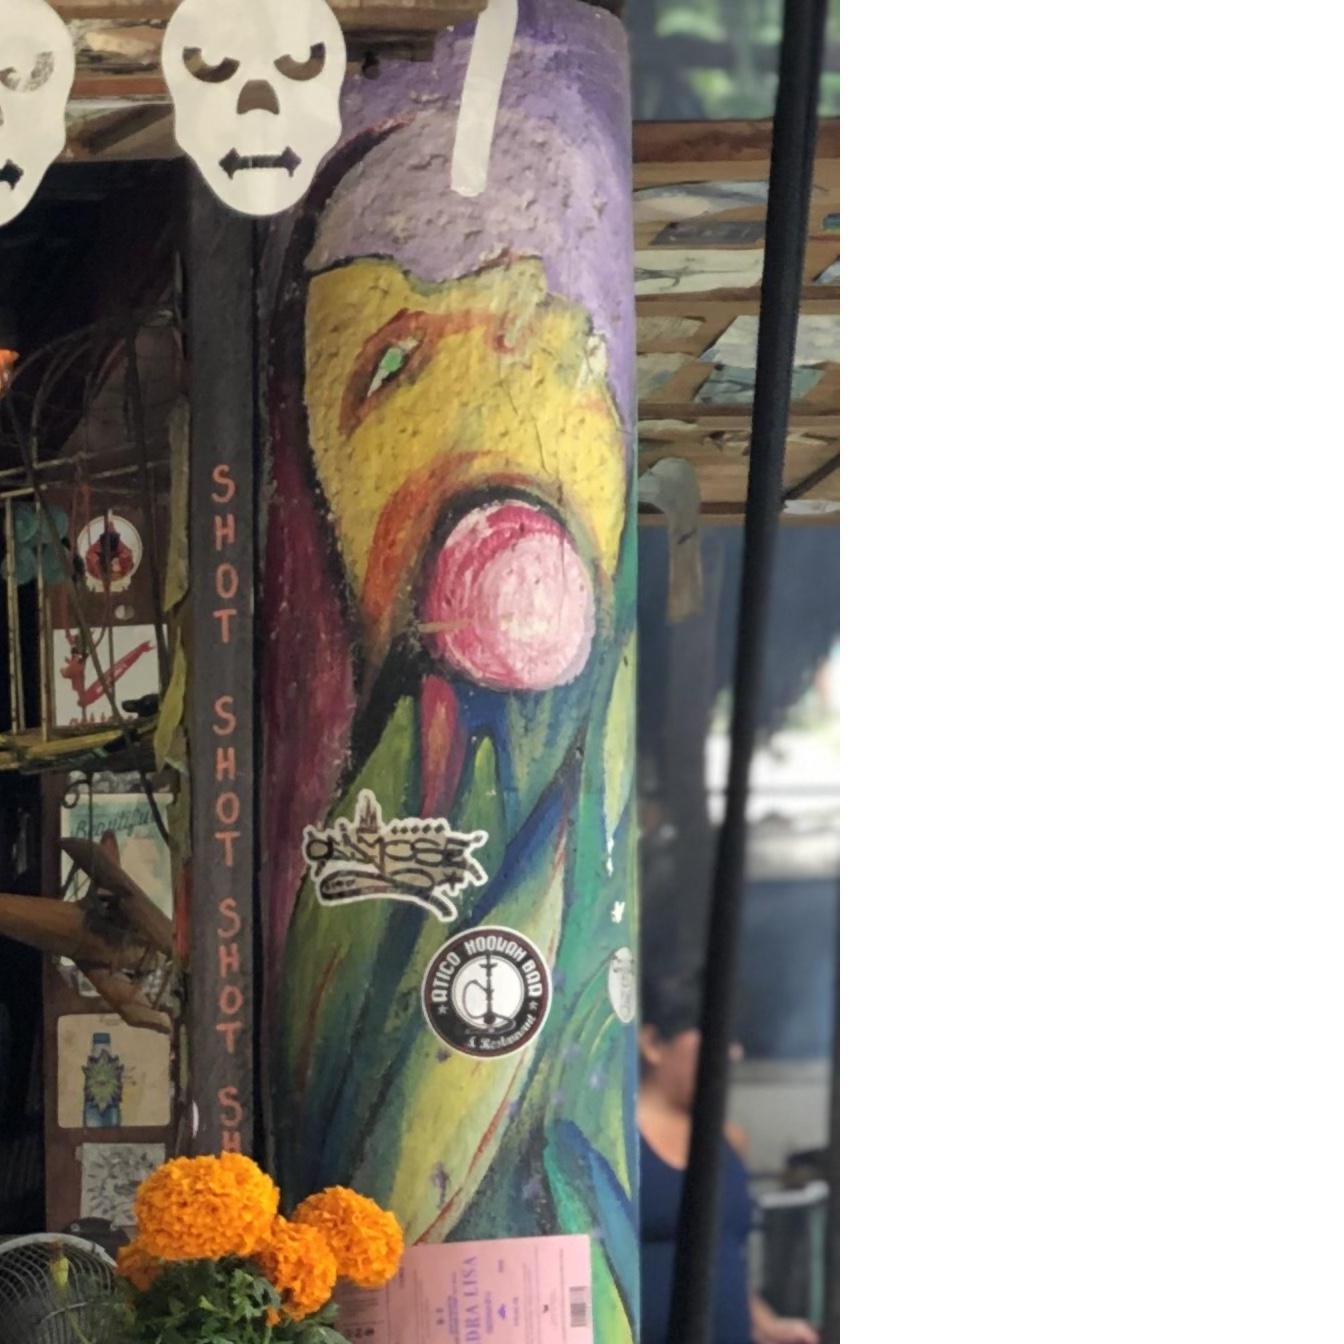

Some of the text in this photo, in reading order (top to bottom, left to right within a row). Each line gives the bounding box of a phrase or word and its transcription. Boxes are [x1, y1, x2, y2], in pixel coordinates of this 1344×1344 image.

[212, 464, 239, 643] SHOT
[212, 695, 240, 866] SHOT
[215, 898, 243, 1053] SHOT
